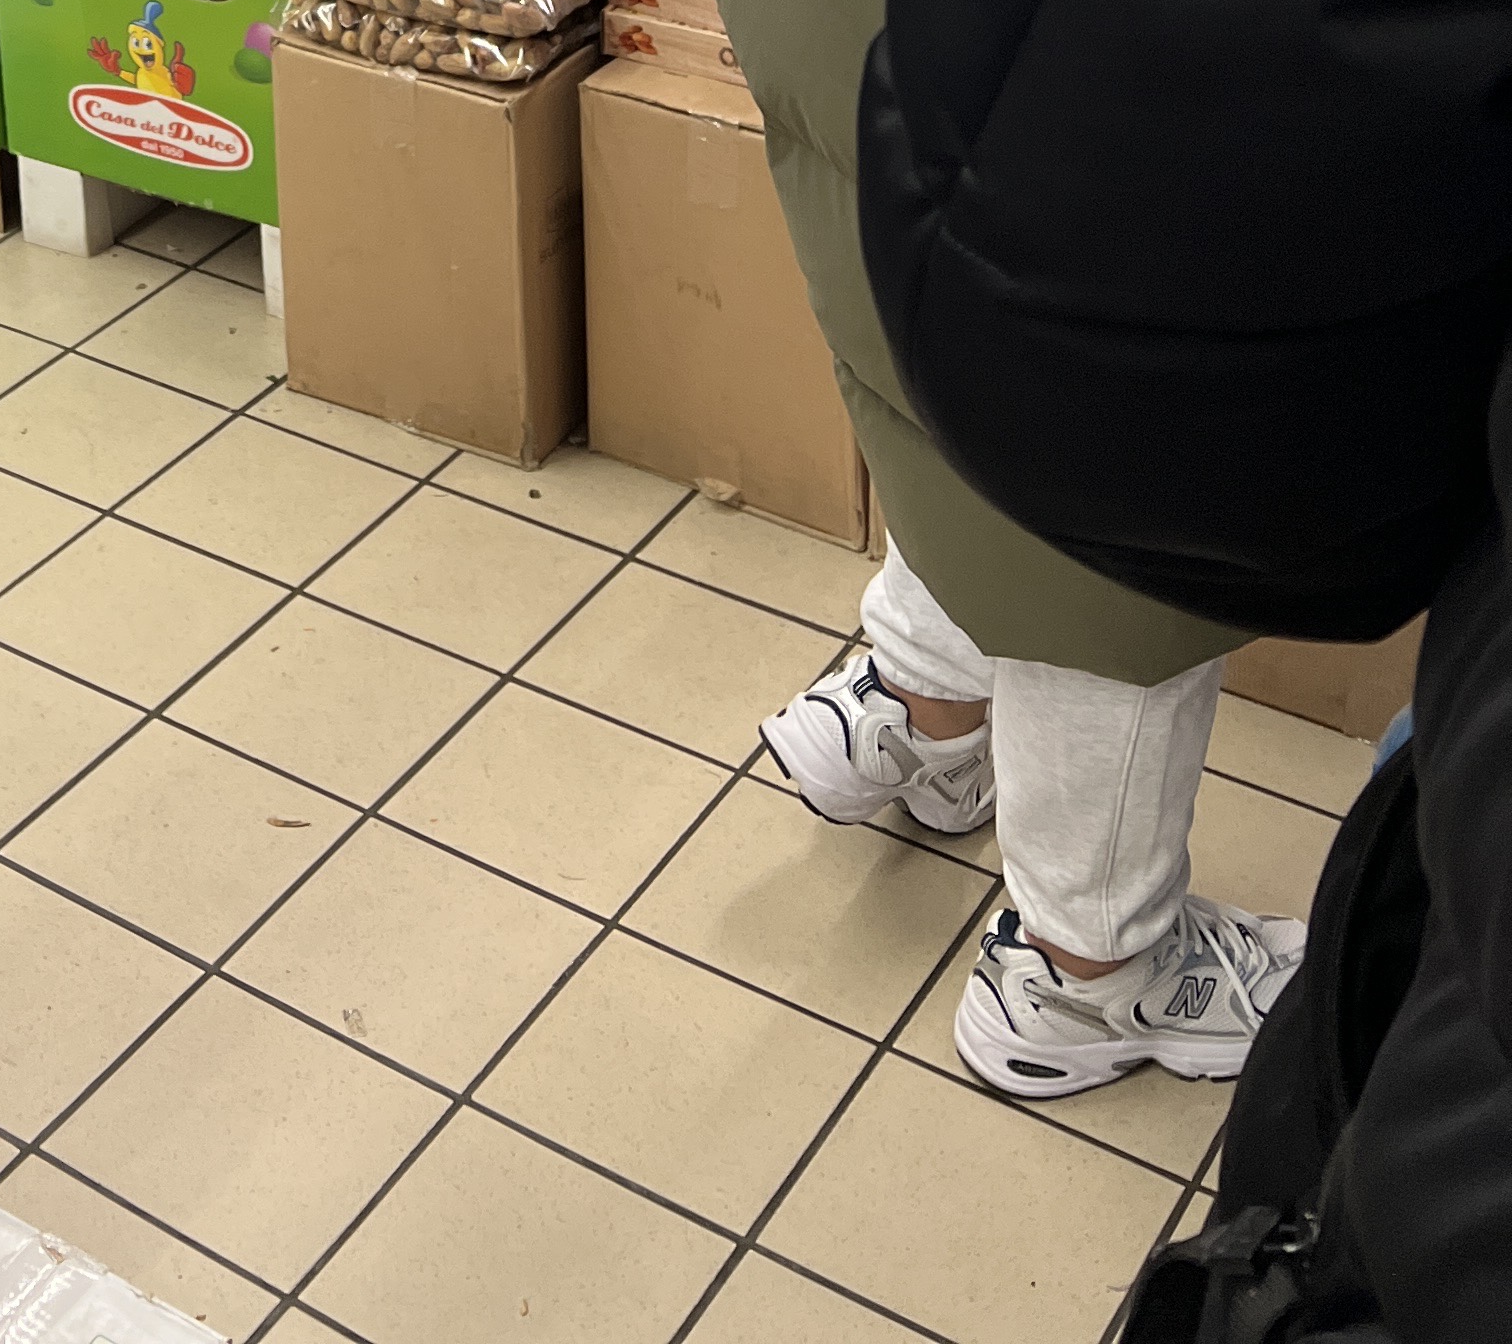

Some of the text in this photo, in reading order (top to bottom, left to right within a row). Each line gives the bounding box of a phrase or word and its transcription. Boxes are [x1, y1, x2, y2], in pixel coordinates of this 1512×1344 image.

[85, 100, 237, 154] Casa del Dolce
[1164, 977, 1217, 1019] N
